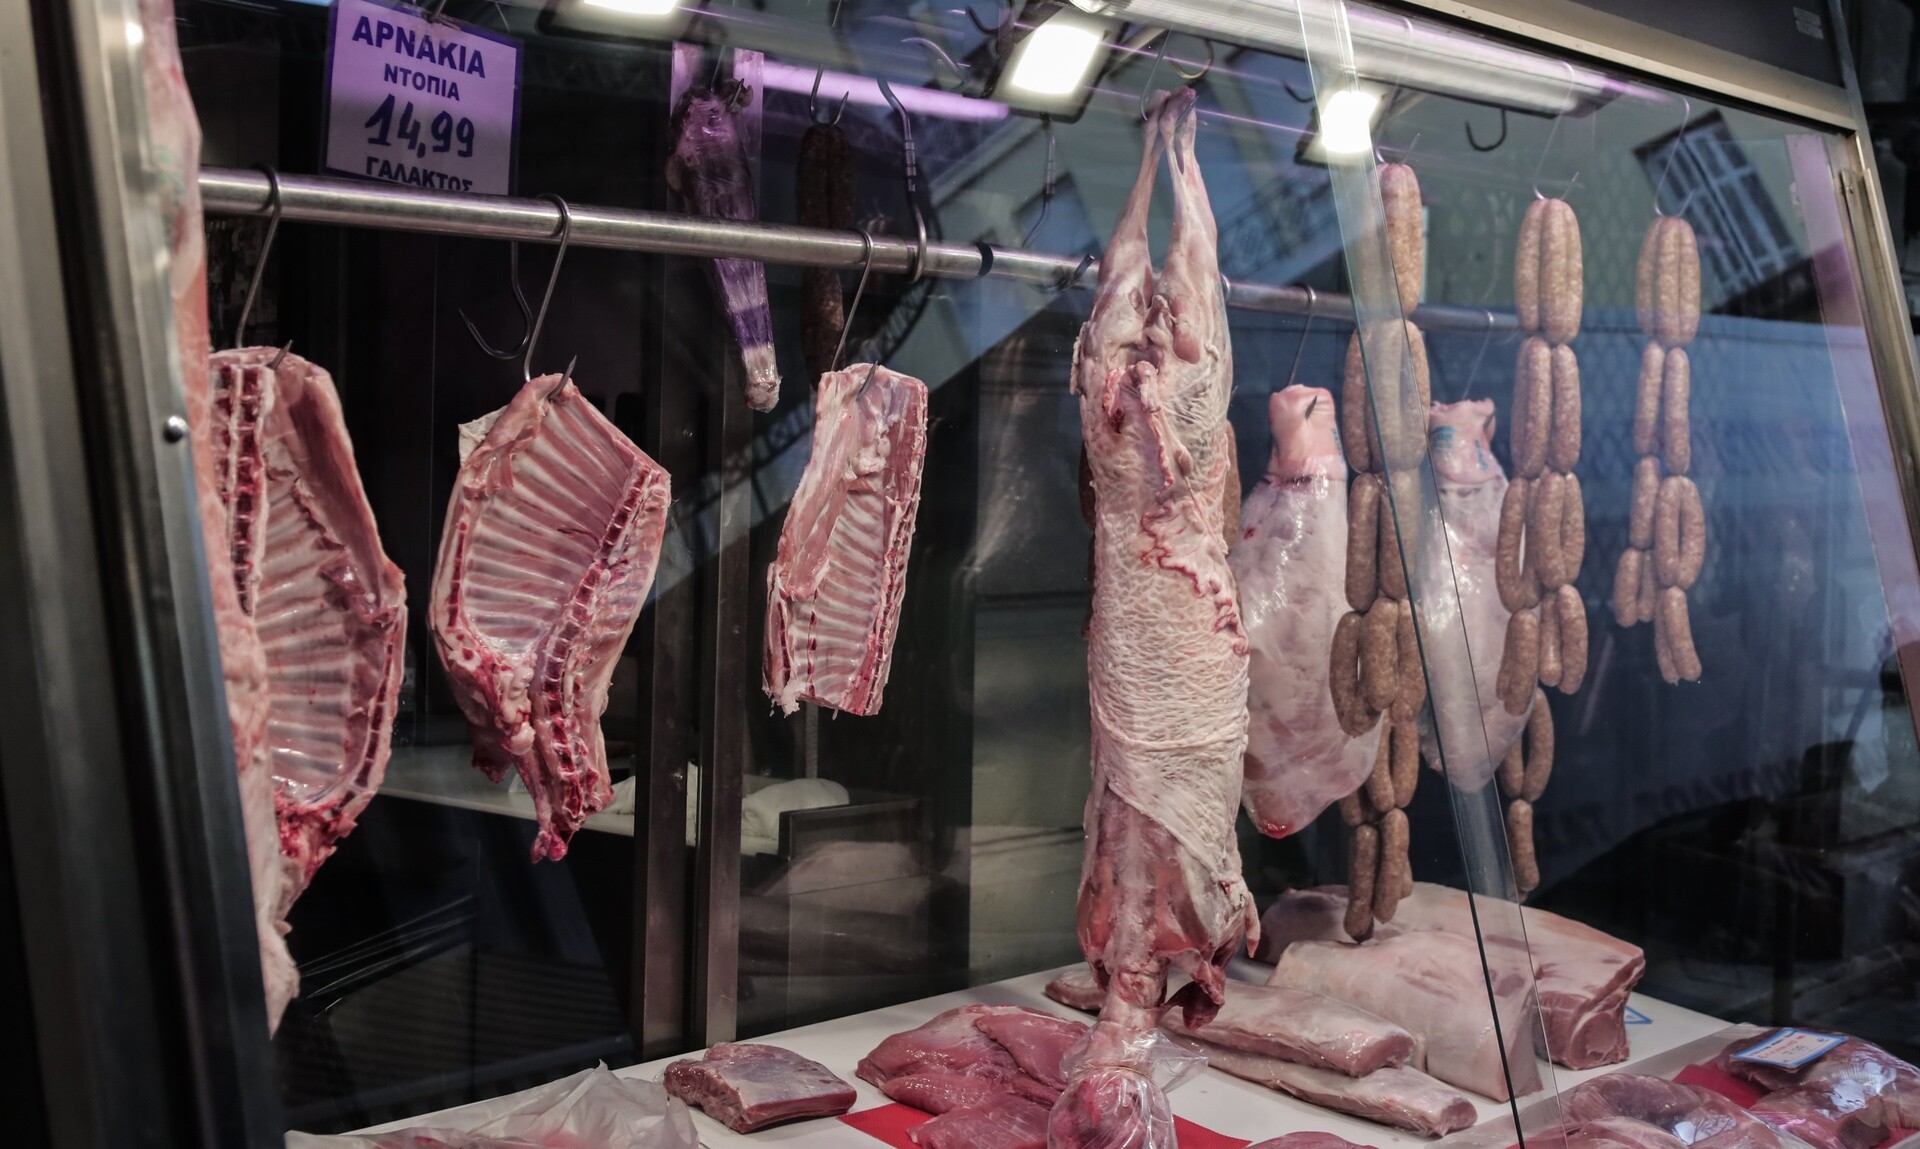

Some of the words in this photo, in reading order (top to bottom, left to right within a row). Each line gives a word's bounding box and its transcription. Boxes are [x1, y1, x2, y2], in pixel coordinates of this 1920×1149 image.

[352, 16, 486, 78] ΑΡΝΑΚΙΑ
[384, 63, 460, 101] ΝΤΟΠΙΑ
[365, 93, 475, 158] 14,99
[366, 156, 473, 191] ΓΑΛΑΚΤΟΣ
